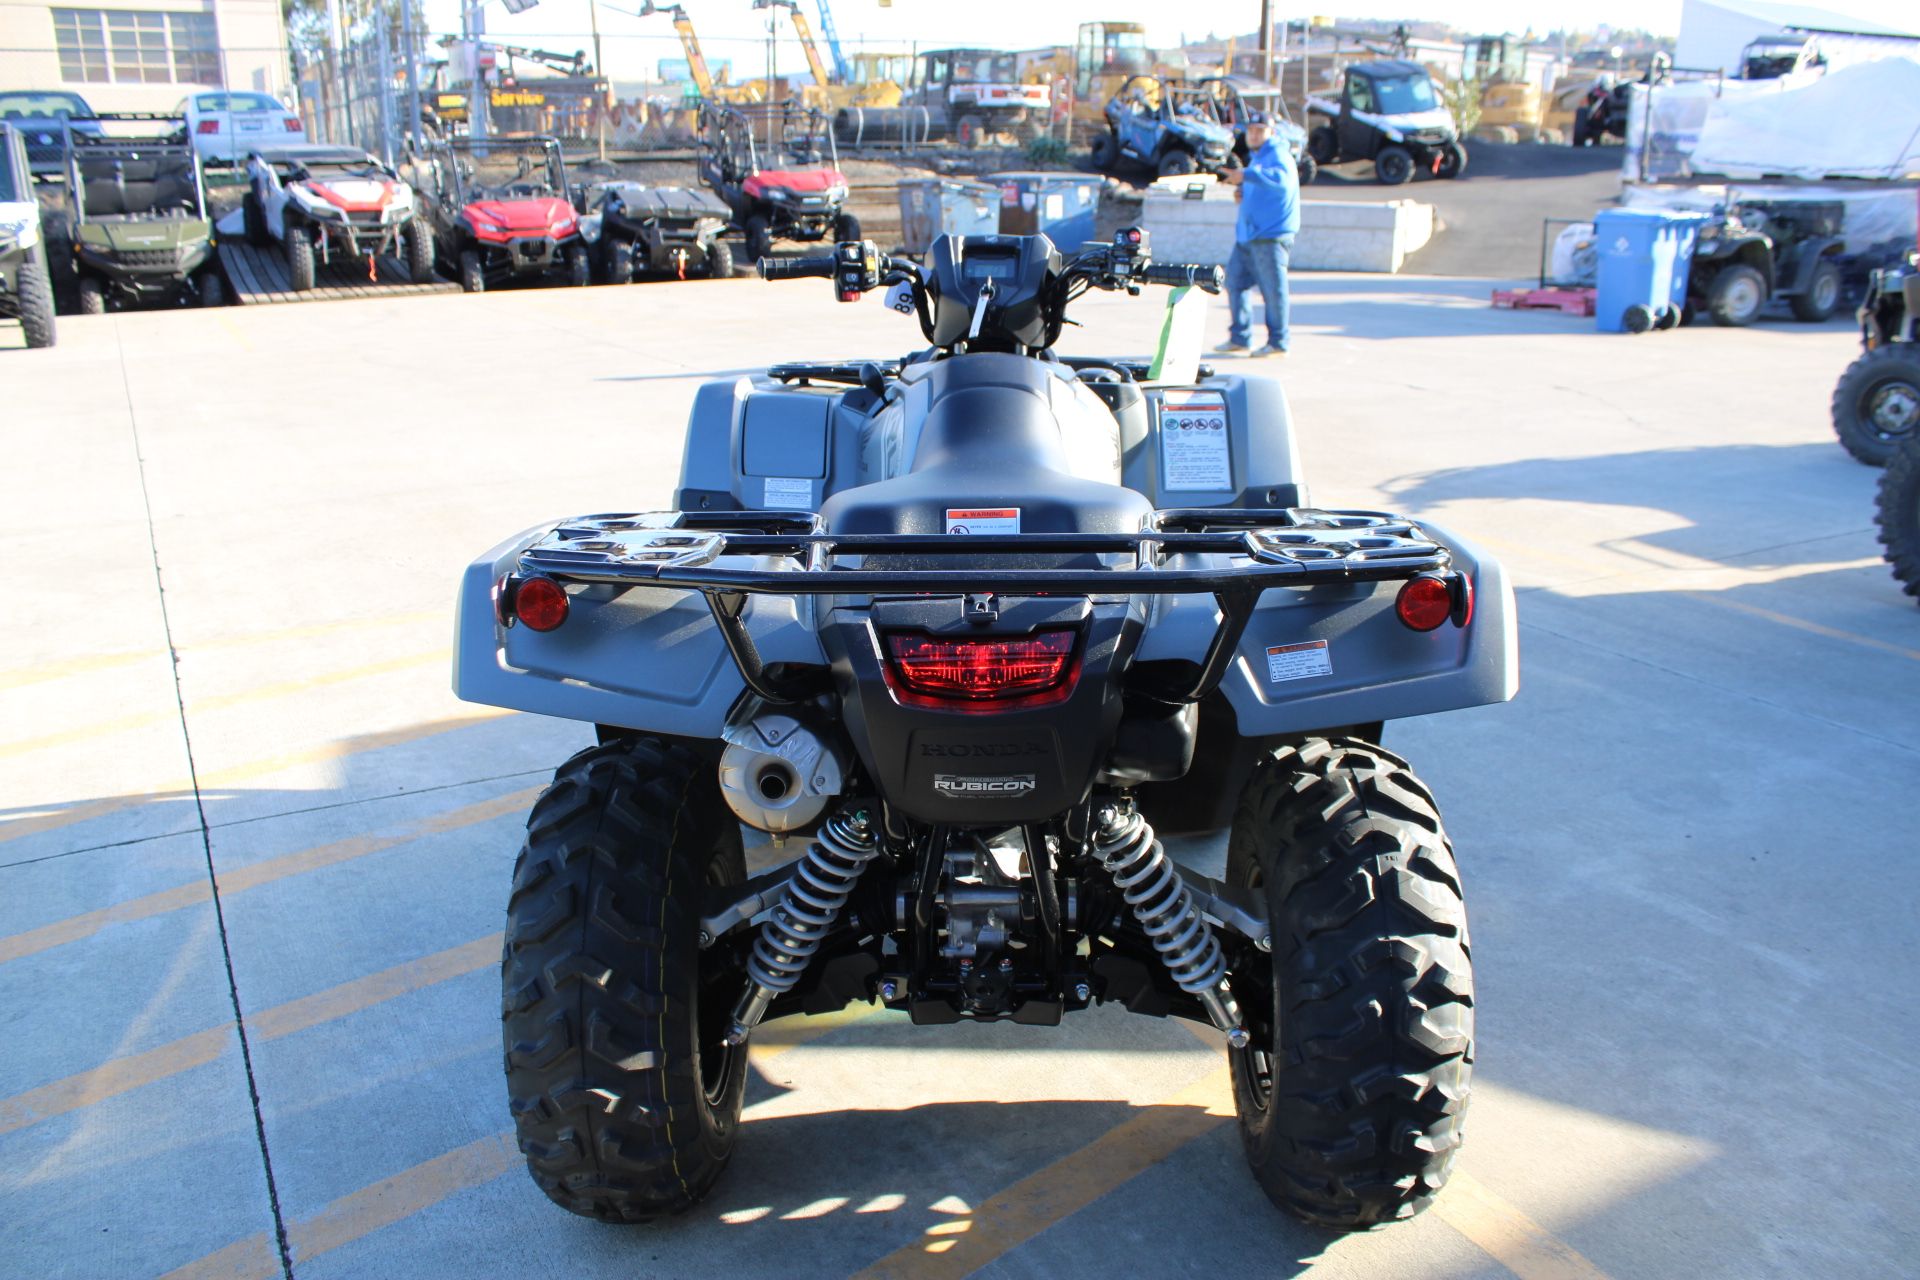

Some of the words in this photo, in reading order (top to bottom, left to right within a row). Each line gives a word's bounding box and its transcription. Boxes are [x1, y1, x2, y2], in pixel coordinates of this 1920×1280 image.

[491, 88, 545, 107] Service
[921, 742, 1048, 757] HONDA
[934, 780, 1036, 791] RUBICON
